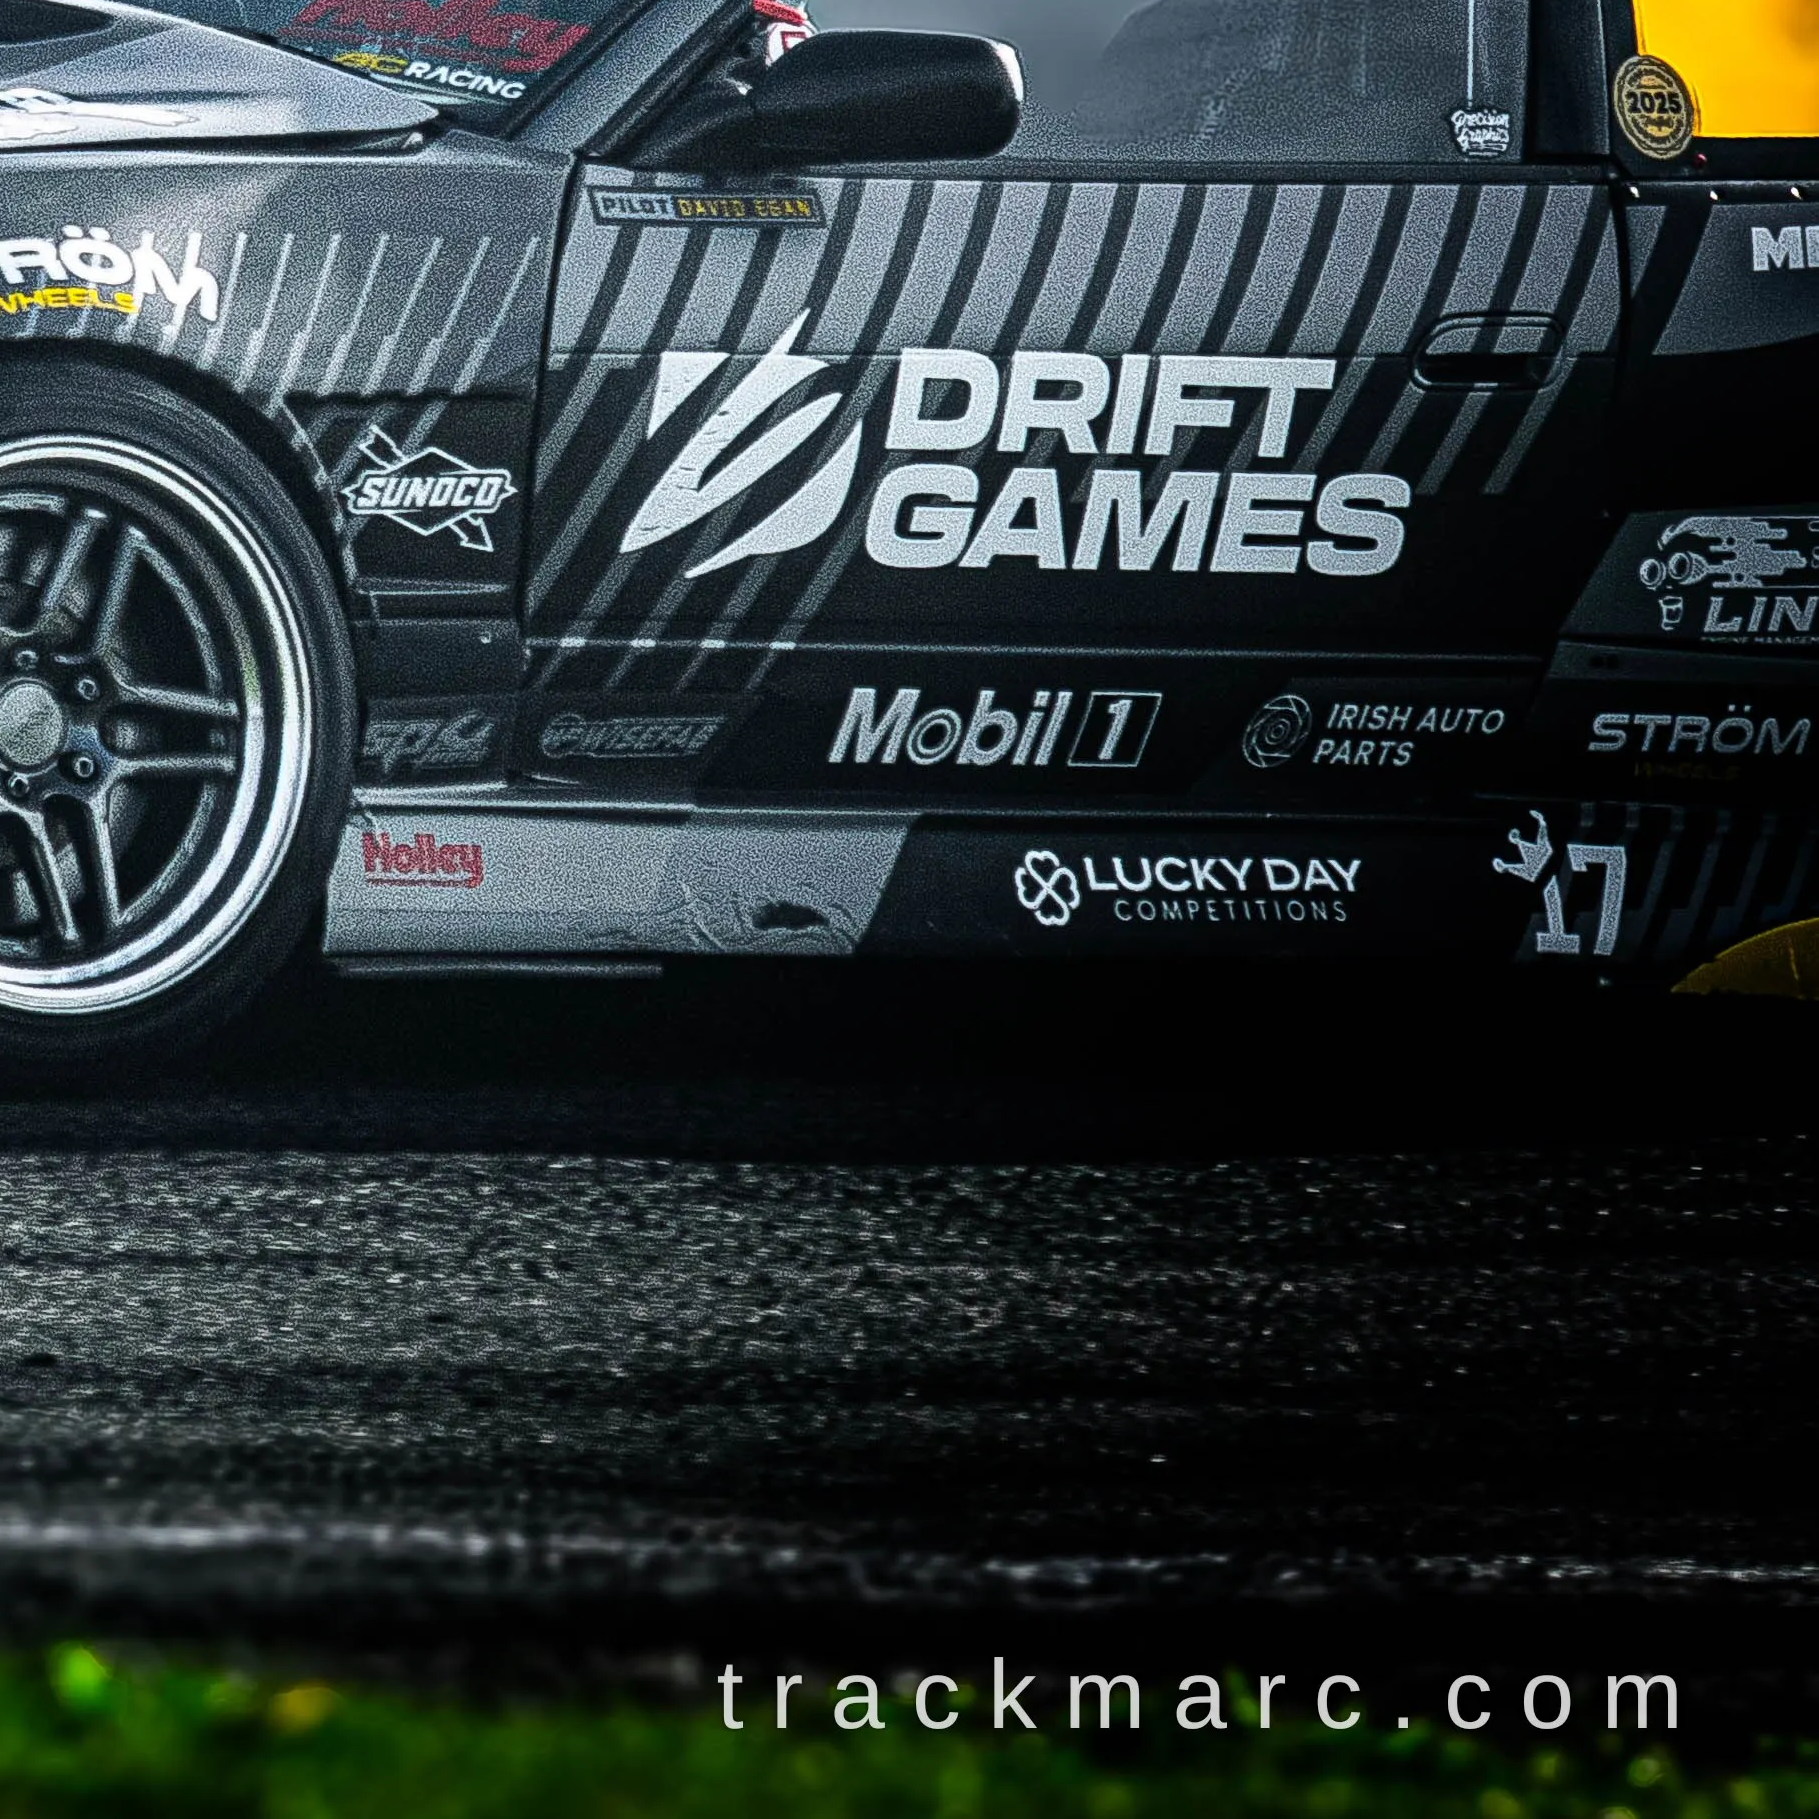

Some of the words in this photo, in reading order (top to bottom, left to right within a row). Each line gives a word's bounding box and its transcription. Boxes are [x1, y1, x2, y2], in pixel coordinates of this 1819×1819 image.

[404, 61, 527, 100] RACING
[1625, 91, 1682, 114] 2025
[602, 198, 669, 215] PILOT
[885, 347, 1338, 459] DRIFT
[358, 474, 505, 510] SUNOCO
[866, 463, 1412, 577] GAMES
[829, 690, 1072, 766] Mobil
[1095, 698, 1135, 761] 1
[1326, 704, 1411, 731] IRISH
[1416, 707, 1505, 735] AUTO
[1588, 704, 1811, 755] STRÖM
[1312, 739, 1416, 767] PARTS
[362, 832, 485, 889] Holley
[1085, 855, 1257, 893] LUCKY
[1261, 858, 1362, 893] DAY
[1114, 898, 1348, 923] COMPETITIONS
[1535, 843, 1627, 956] 17
